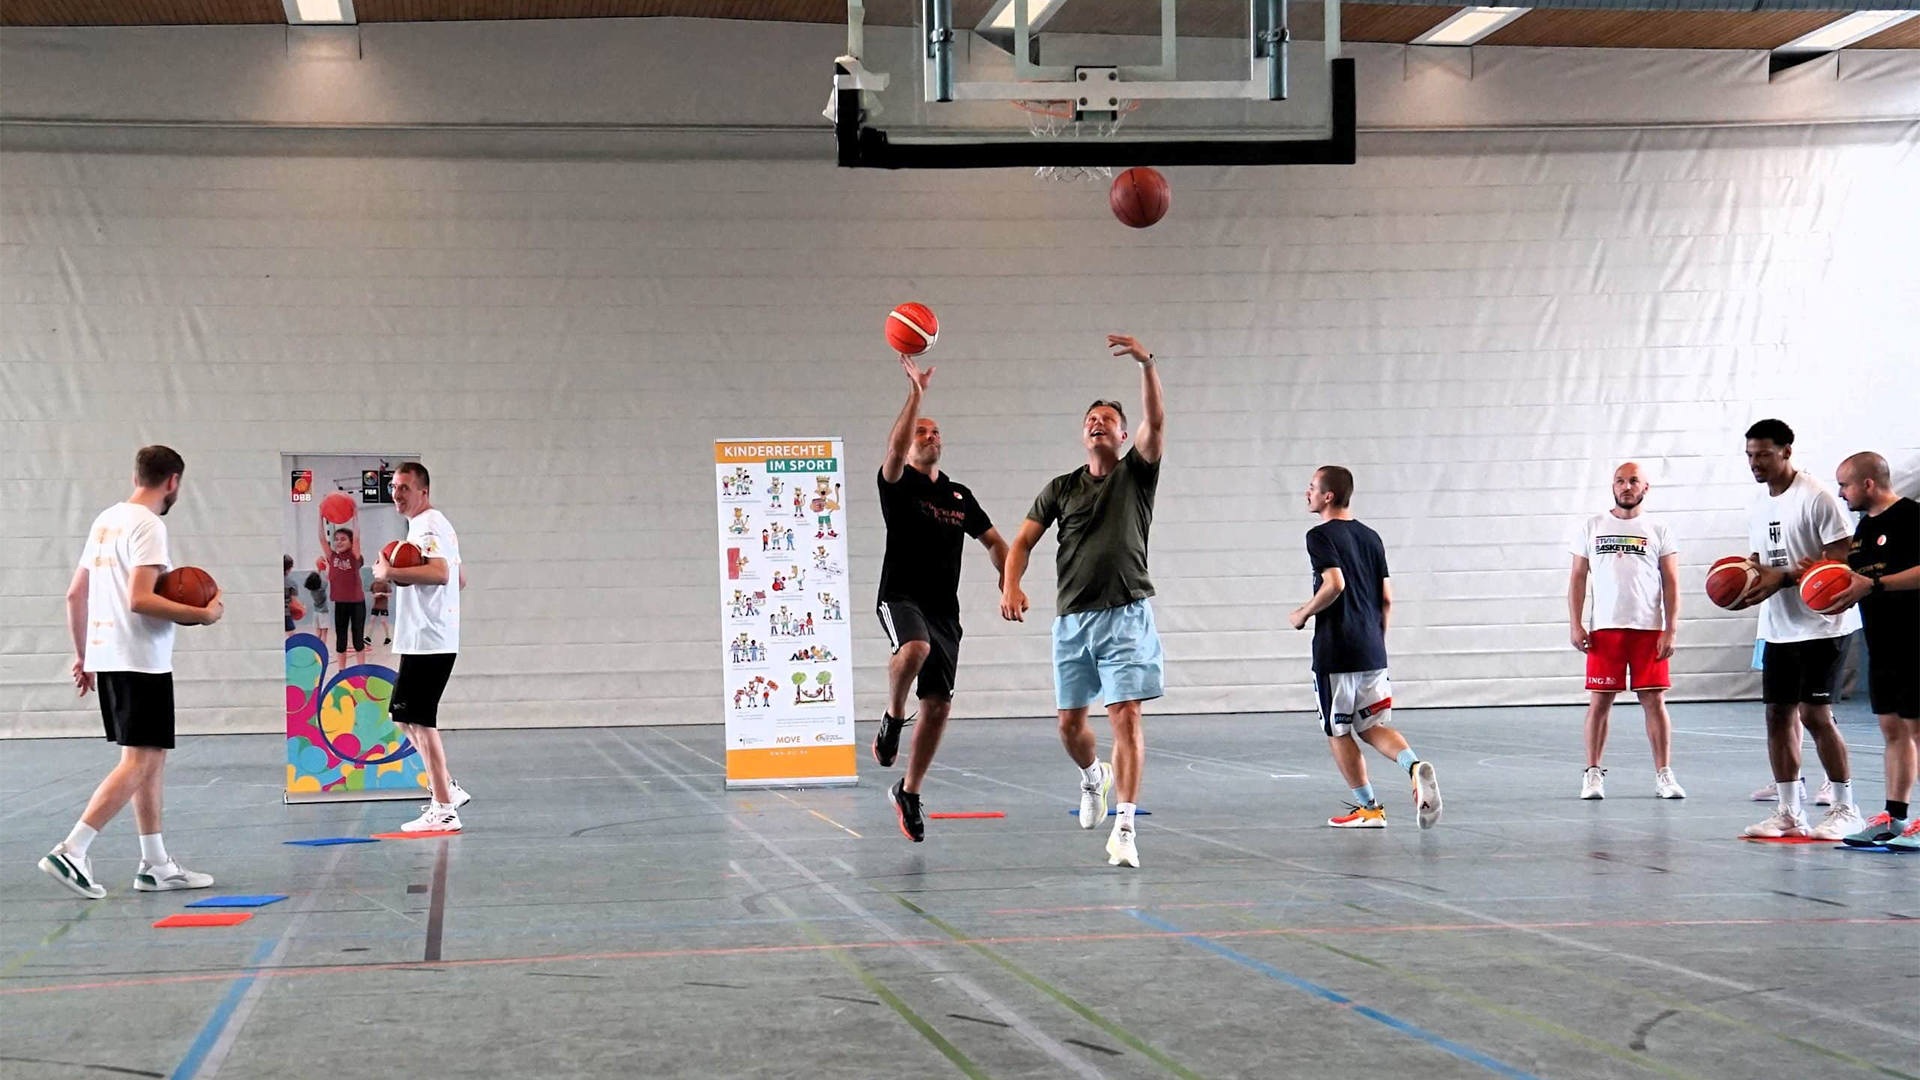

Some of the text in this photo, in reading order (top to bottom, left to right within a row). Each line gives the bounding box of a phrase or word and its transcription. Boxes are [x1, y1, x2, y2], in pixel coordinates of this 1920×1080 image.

[724, 445, 825, 457] KINDERRECHTE
[770, 460, 833, 471] IM SPORT
[293, 493, 312, 501] DBB
[1595, 544, 1646, 553] BASKETBALL
[1588, 677, 1604, 685] ING
